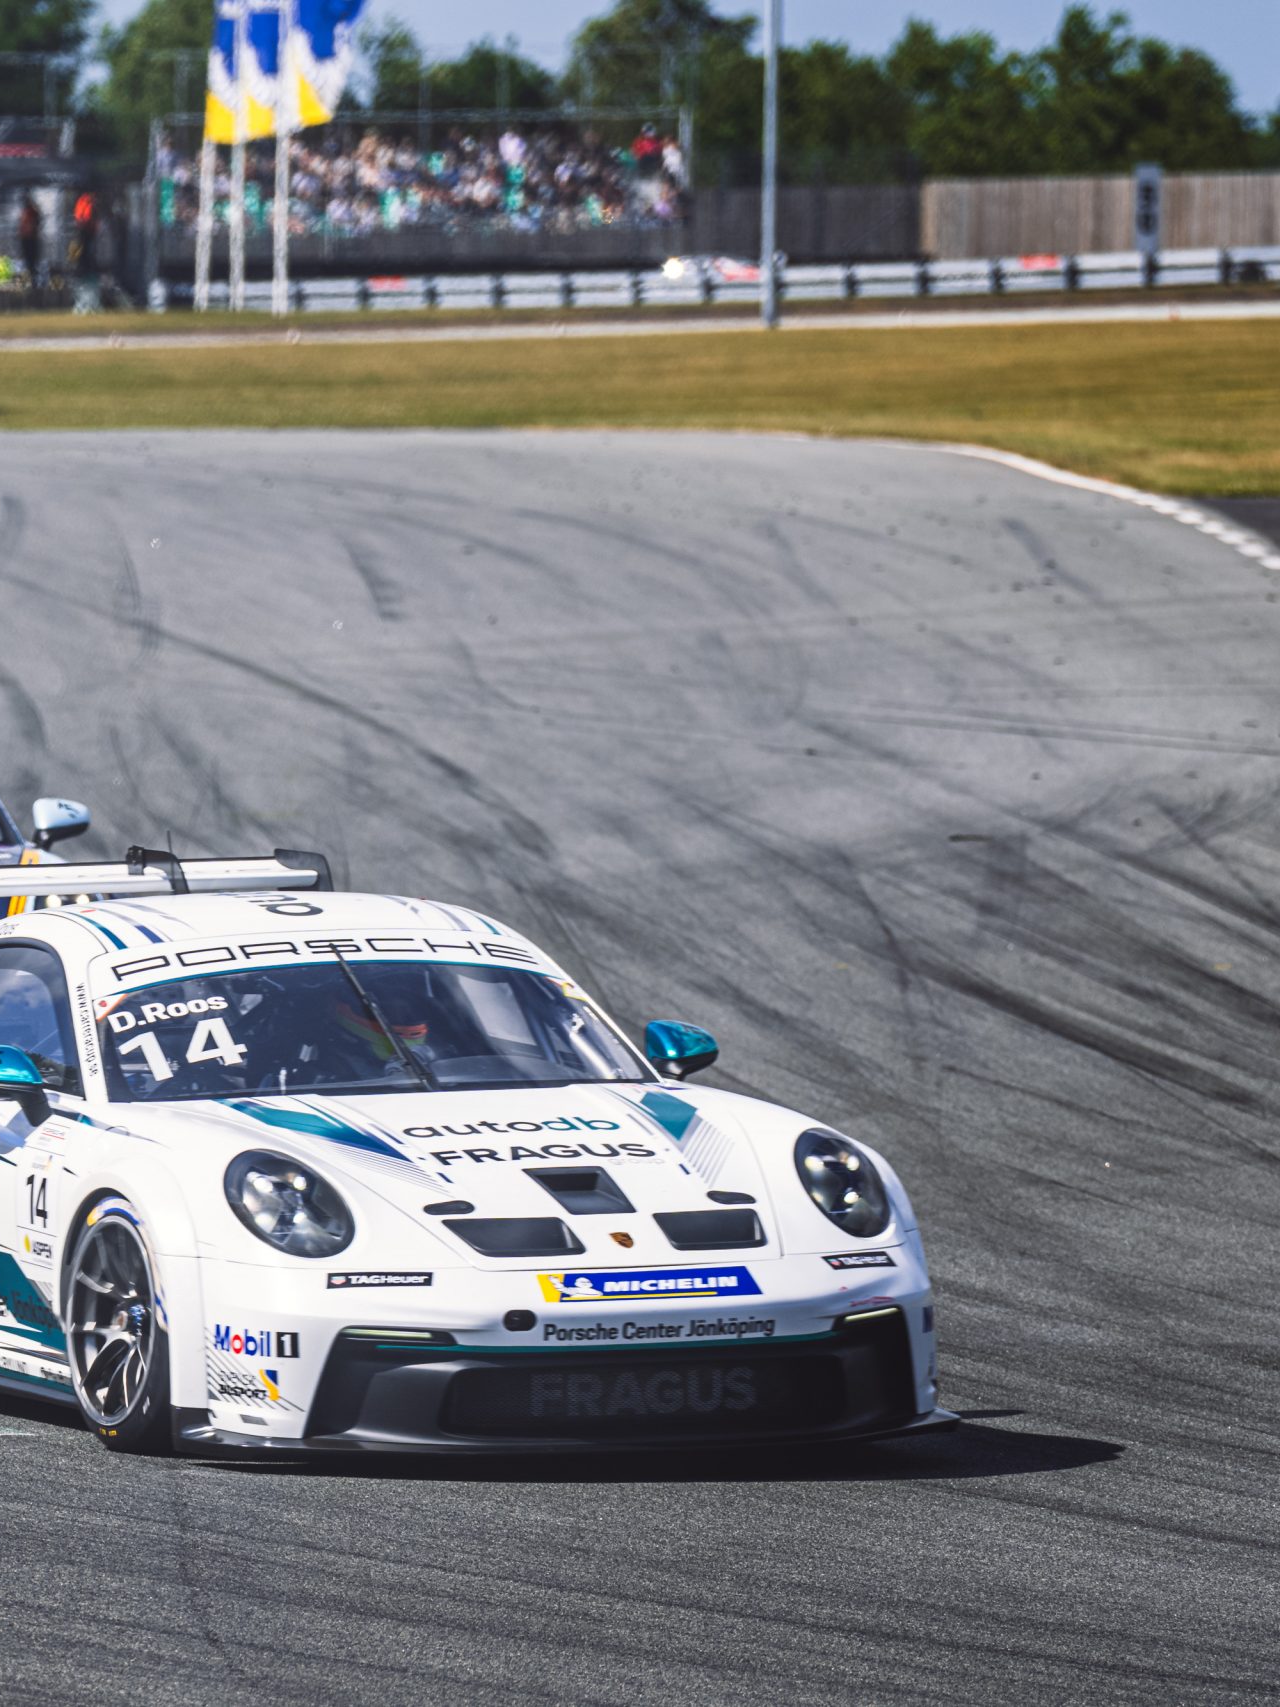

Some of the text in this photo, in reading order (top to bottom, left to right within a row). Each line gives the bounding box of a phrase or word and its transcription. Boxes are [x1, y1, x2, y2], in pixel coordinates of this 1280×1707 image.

[111, 938, 538, 982] PORSCHE
[107, 996, 229, 1033] D.Roos
[118, 1017, 249, 1082] 14
[402, 1116, 620, 1139] autodb
[429, 1143, 657, 1166] FRAGUS
[26, 1173, 48, 1229] 14
[603, 1275, 739, 1293] MICHELIN
[213, 1323, 271, 1357] Mobil
[543, 1316, 776, 1342] Porsche Center Jönköping
[529, 1366, 758, 1417] FRAGUS
